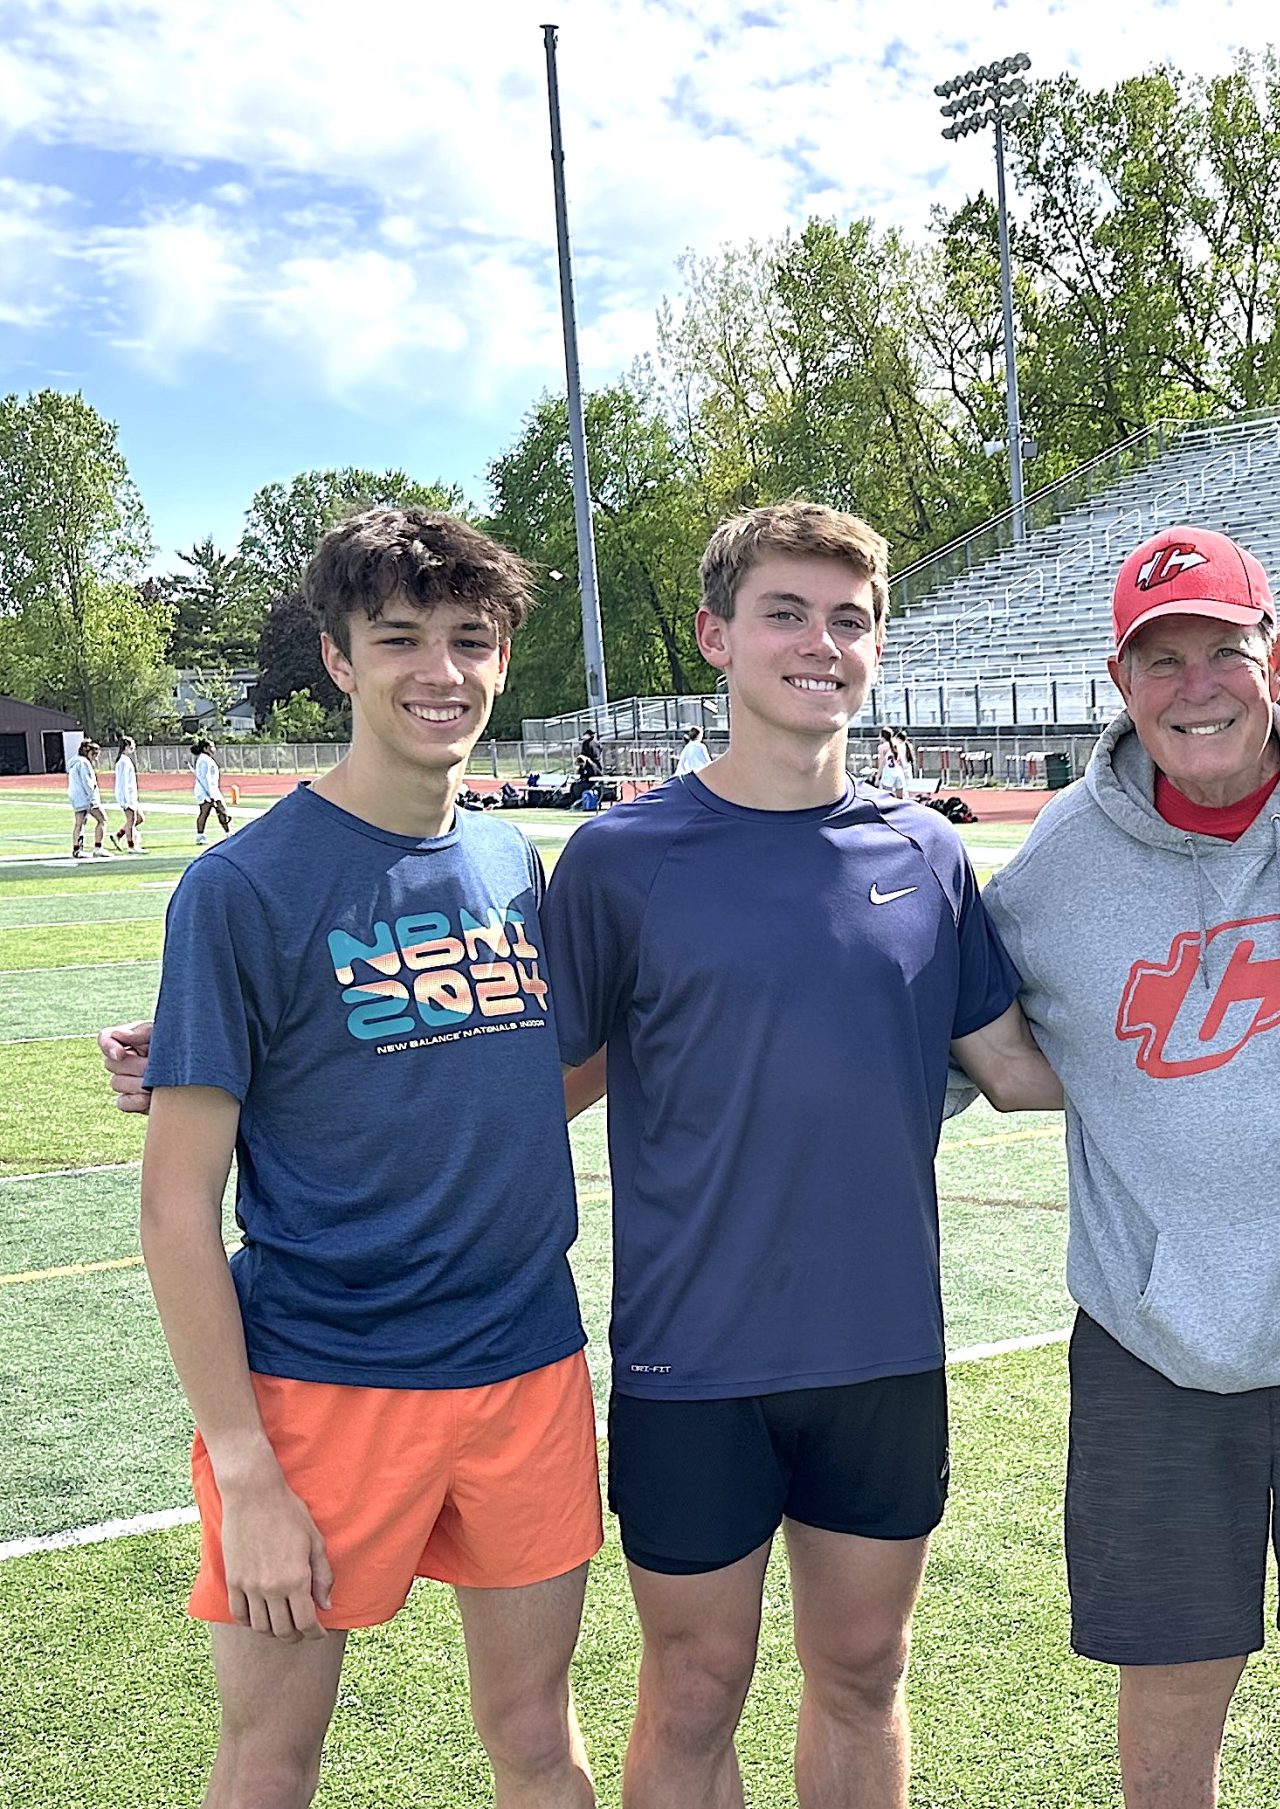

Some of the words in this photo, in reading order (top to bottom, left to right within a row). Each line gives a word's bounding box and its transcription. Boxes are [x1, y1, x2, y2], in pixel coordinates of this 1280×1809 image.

[1147, 543, 1196, 590] C
[887, 755, 895, 768] 3
[327, 907, 539, 985] NBNI
[341, 961, 548, 1041] 2024
[376, 1042, 408, 1054] NEW
[409, 1031, 462, 1048] BALANCE
[630, 1364, 672, 1373] DRI-FIT
